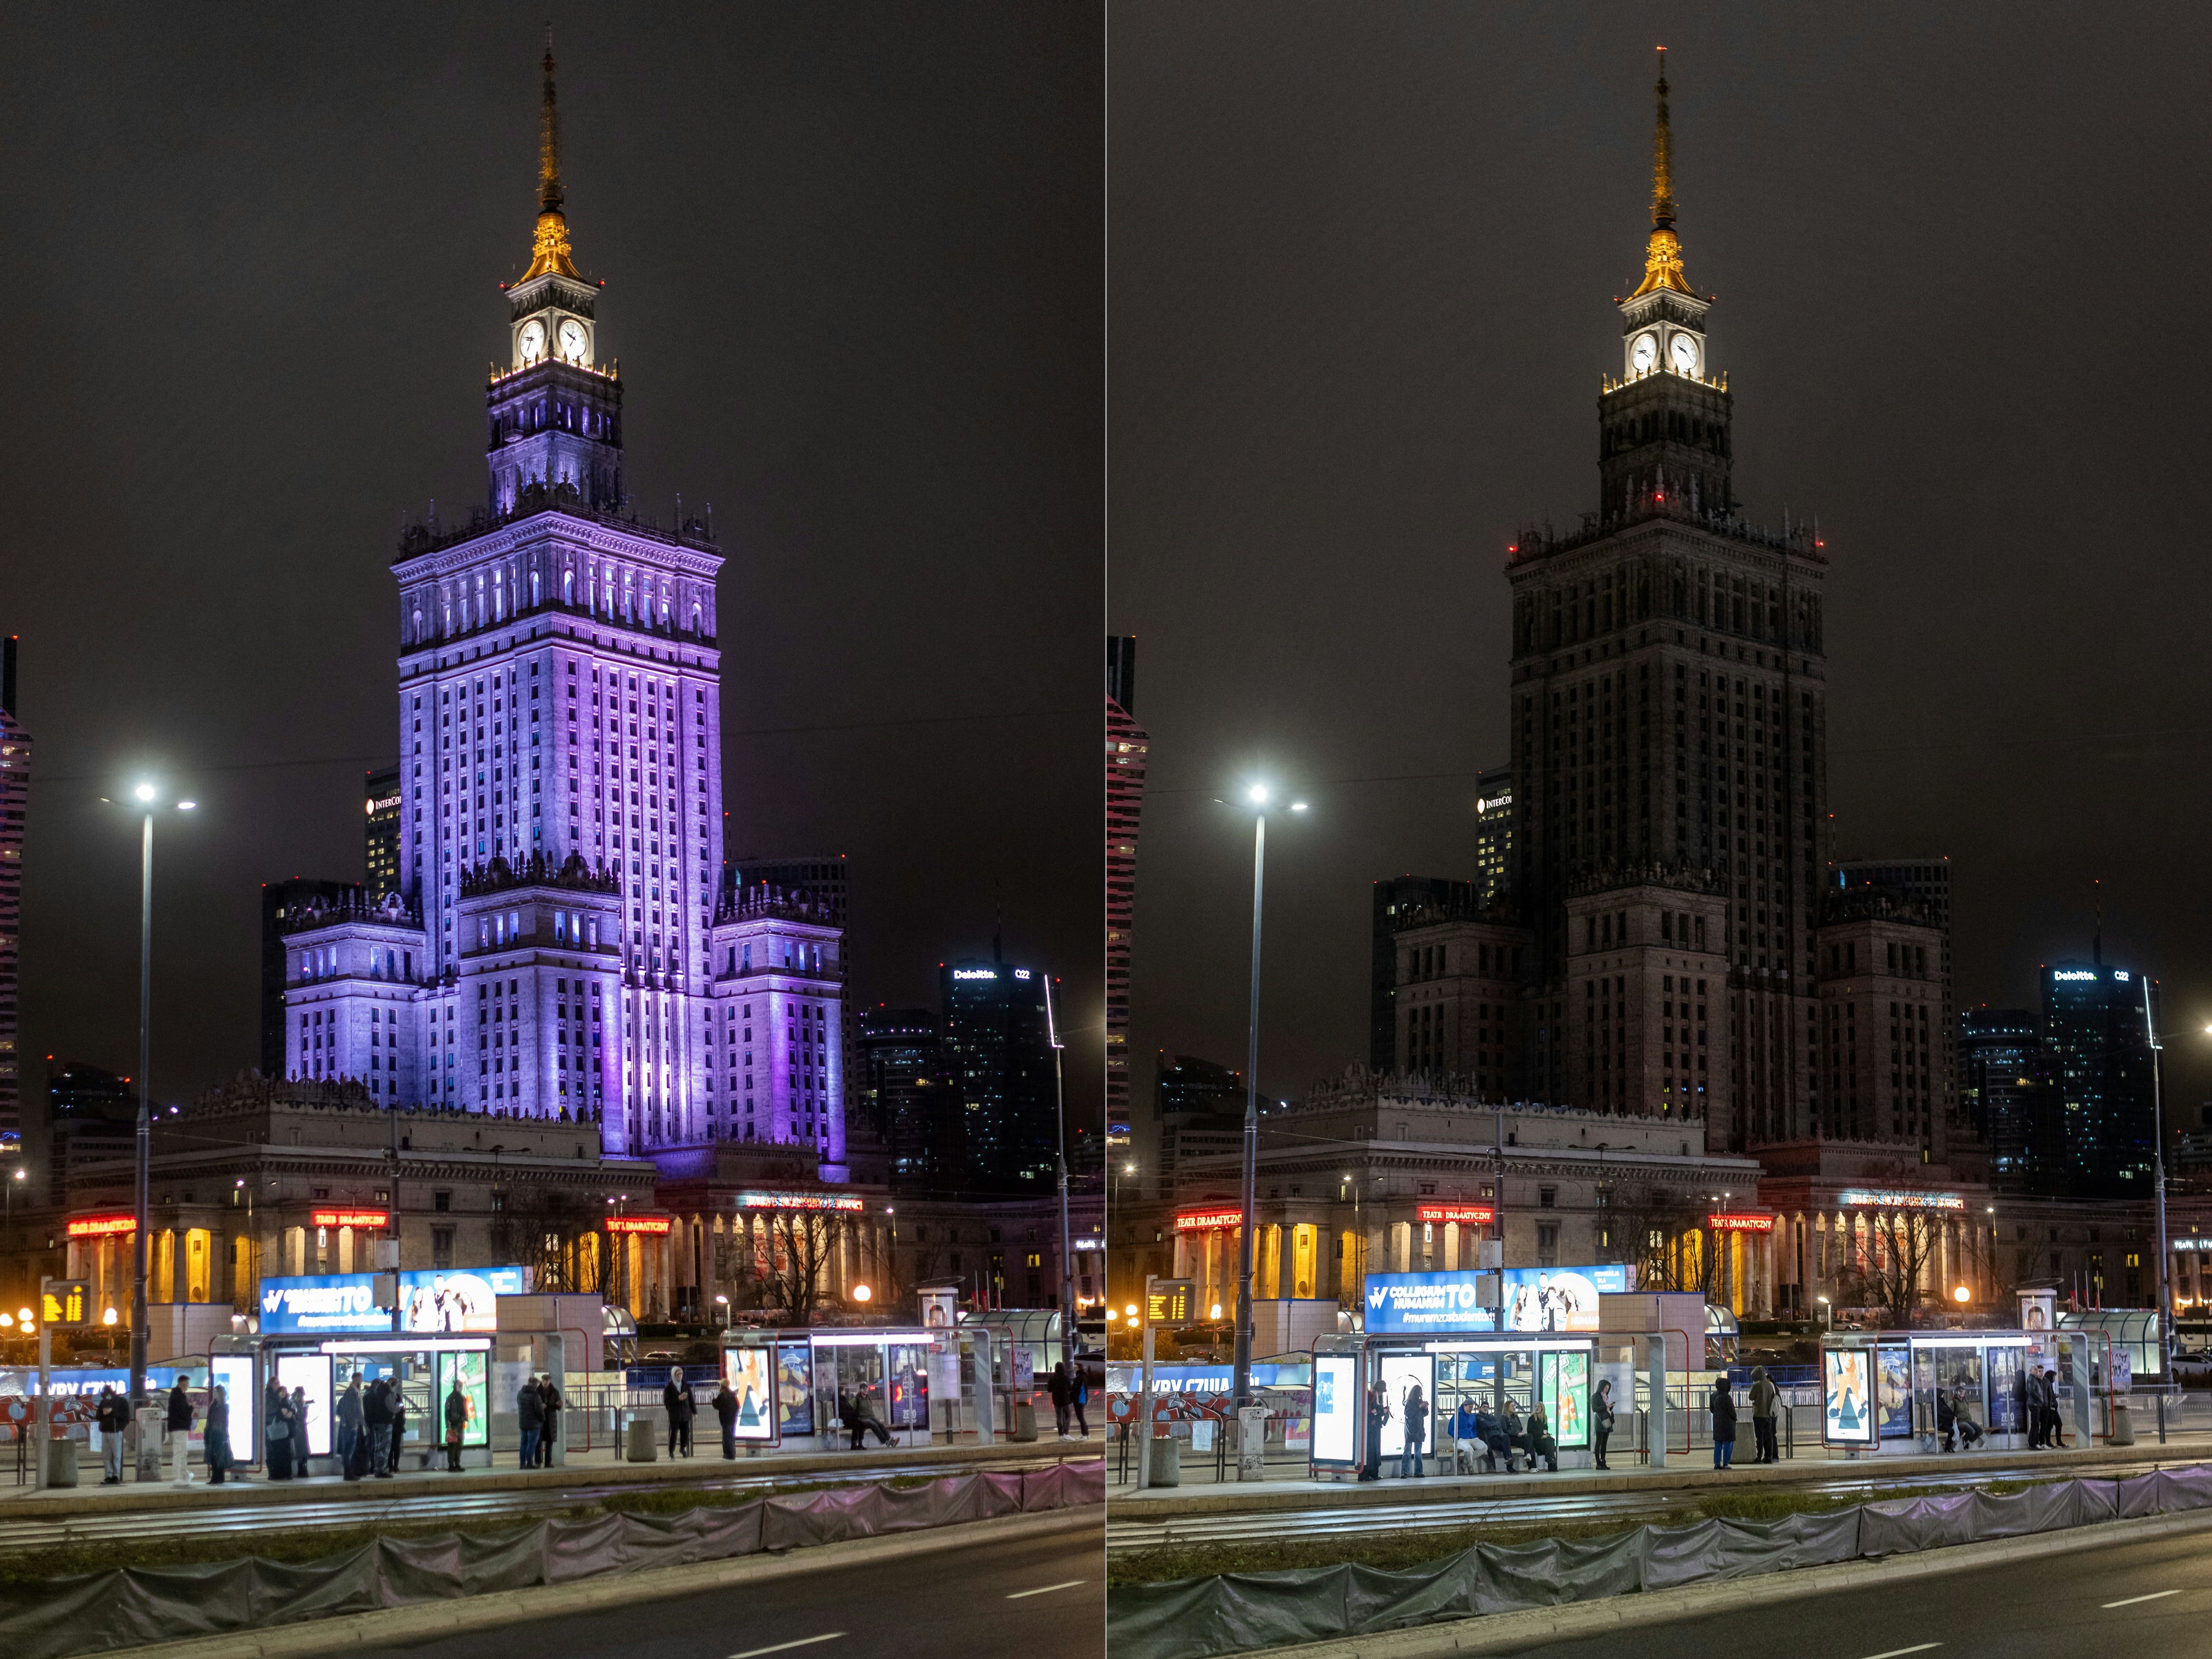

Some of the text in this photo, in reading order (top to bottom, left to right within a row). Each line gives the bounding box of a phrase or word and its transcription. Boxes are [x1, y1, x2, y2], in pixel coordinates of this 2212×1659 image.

[316, 1215, 337, 1224] TEATR
[1422, 1210, 1490, 1219] TEATR DRAMATYCZNY
[607, 1221, 669, 1232] TEATR DRAMATYCZNY
[1177, 1217, 1196, 1228] TEATR
[1711, 1218, 1772, 1229] TEATR DRAMATYCZNY
[2174, 1241, 2194, 1249] TEATR
[1389, 1285, 1446, 1298] COLLEGIUM
[1394, 1297, 1445, 1309] HUMANUM
[903, 1409, 917, 1418] ZEO
[2001, 1412, 2014, 1422] ZEO
